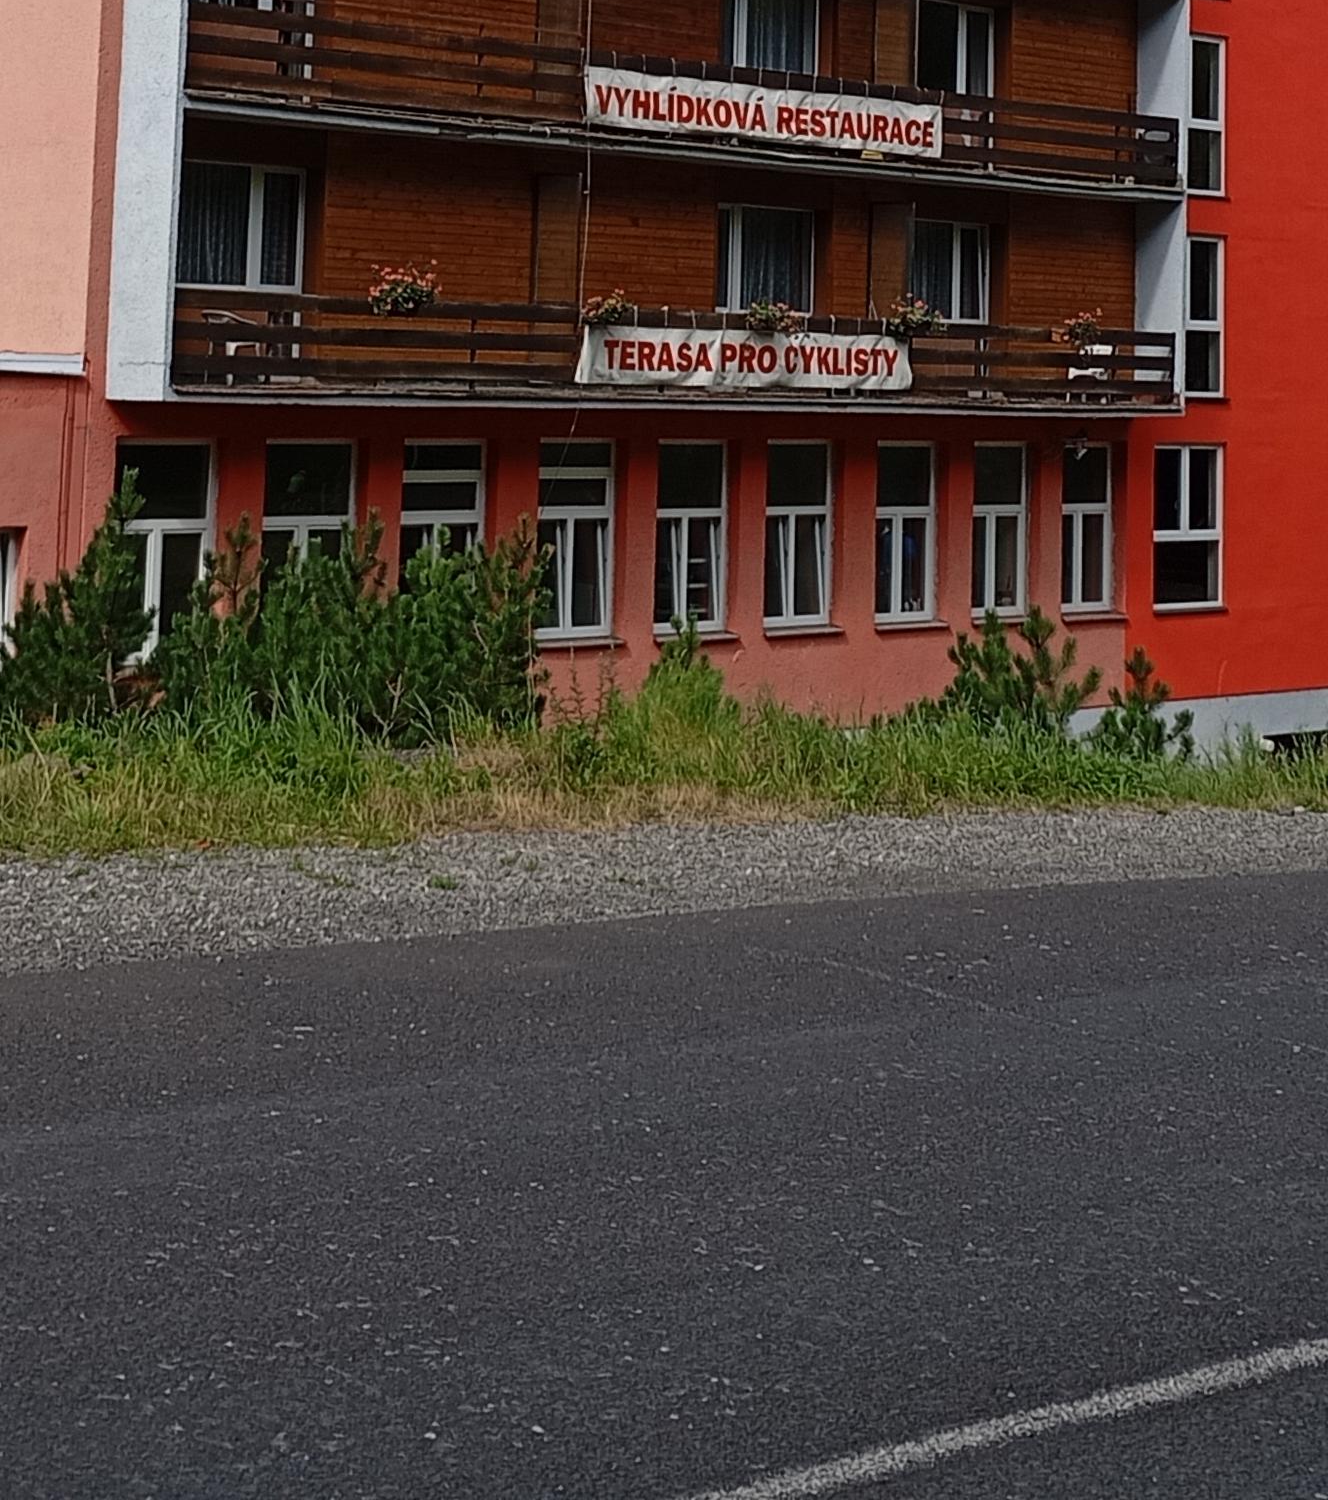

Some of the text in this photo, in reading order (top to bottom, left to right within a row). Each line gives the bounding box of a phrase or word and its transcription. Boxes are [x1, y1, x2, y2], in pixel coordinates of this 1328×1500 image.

[594, 85, 935, 149] VYHLÍDKOVÁ RESTAURACE
[603, 339, 899, 378] TERASA PRO CYKLISTY
